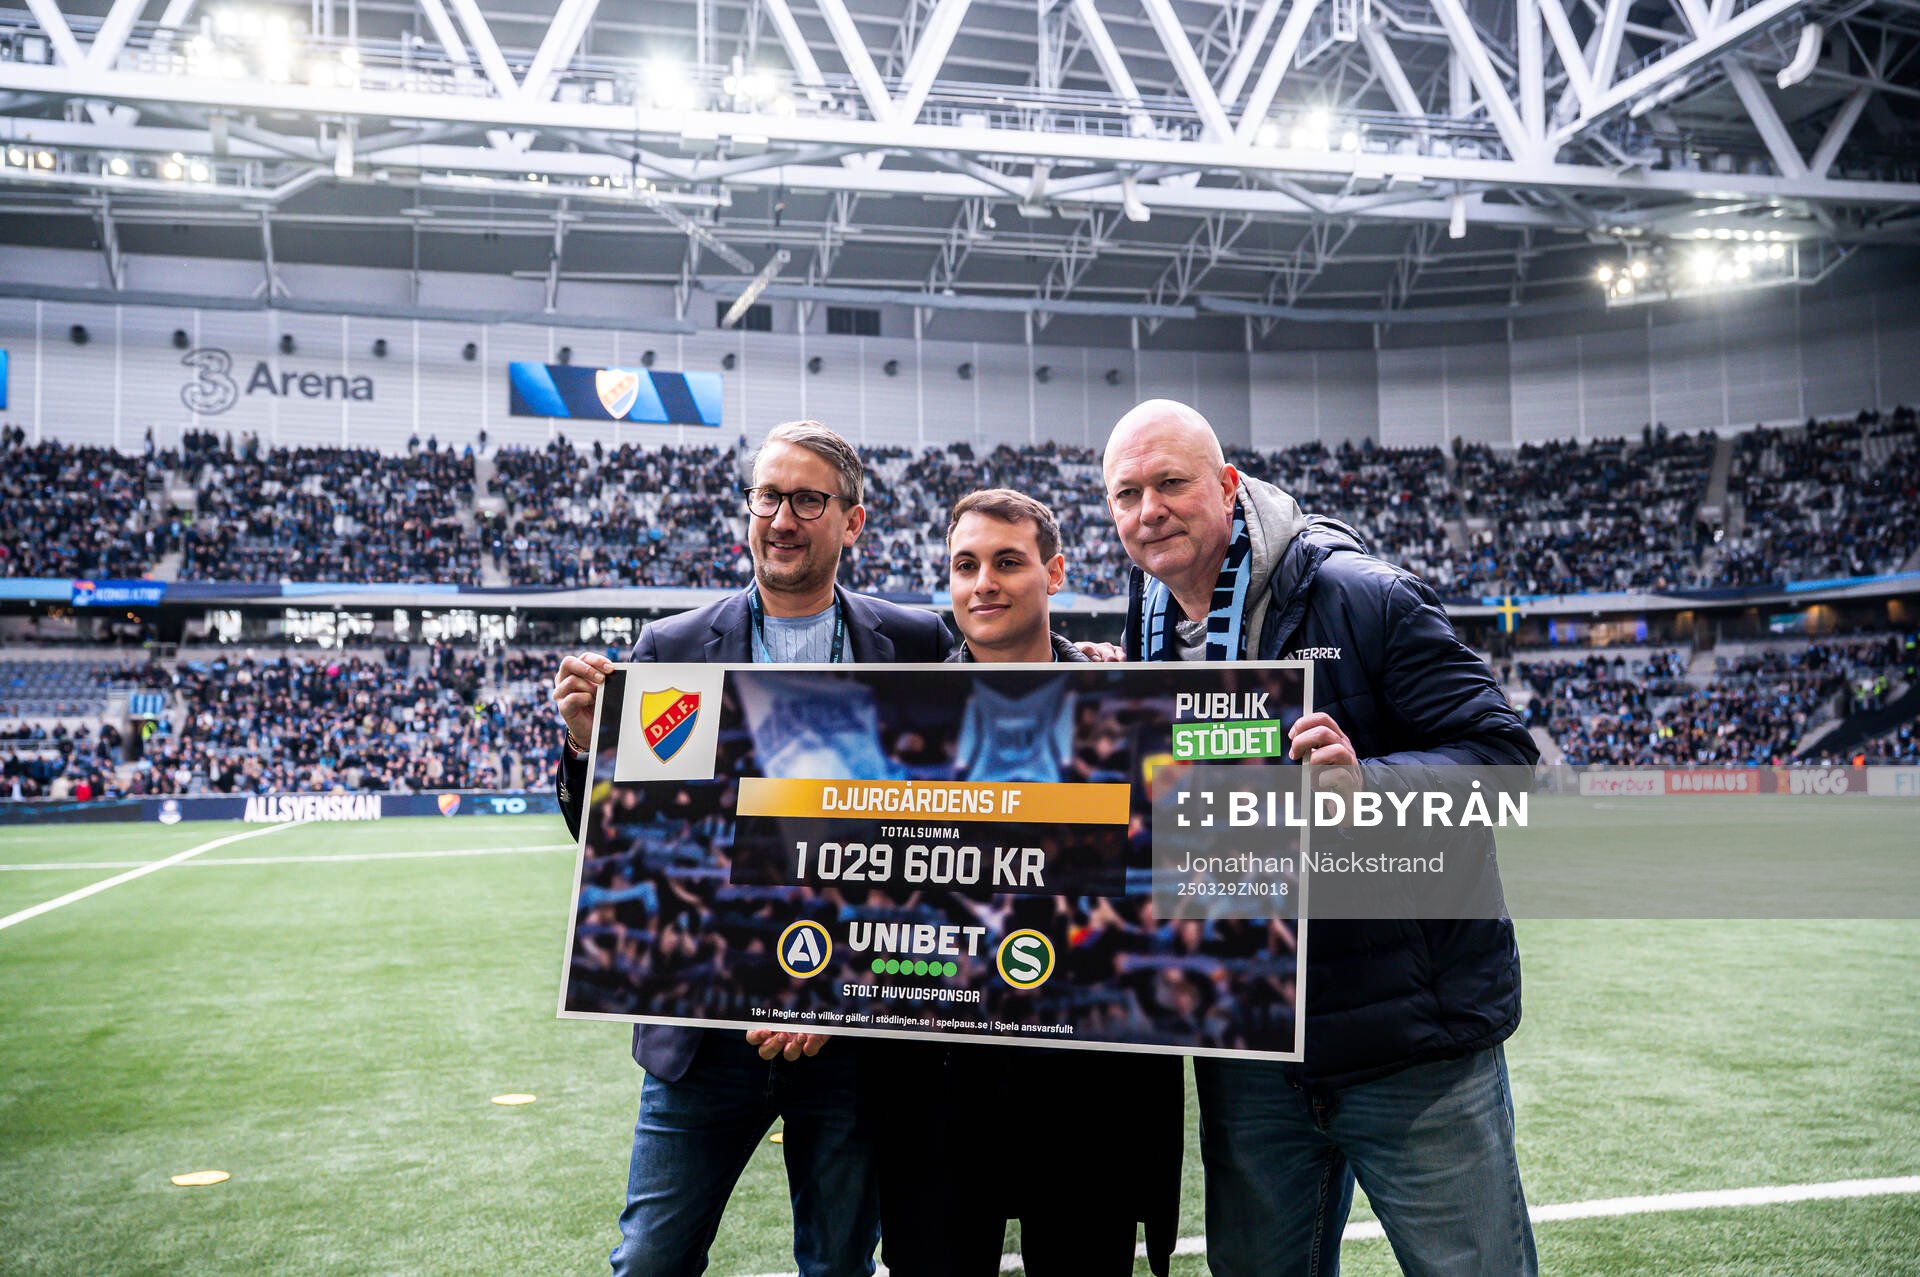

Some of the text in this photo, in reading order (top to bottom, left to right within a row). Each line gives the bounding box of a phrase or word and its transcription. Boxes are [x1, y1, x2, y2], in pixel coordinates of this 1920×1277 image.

[245, 360, 374, 401] Arena
[1295, 647, 1342, 660] TERREX
[1175, 692, 1270, 719] PUBLIK
[1175, 724, 1278, 757] STÖDET
[1670, 773, 1748, 792] BAUHAUS
[1790, 769, 1849, 795] BYGG
[244, 795, 382, 823] ALLSVENSKAN
[821, 781, 1022, 814] DJURGÅRDENS IF
[880, 826, 960, 840] TOTALSUMMA
[795, 841, 1046, 888] 1 029 600 KR
[848, 921, 986, 957] UNIBET
[842, 984, 981, 1003] STOLT HUVUDSPONSOR
[751, 1007, 1074, 1034] 18+ Regler och villkor gäller stödlinjen.se spelpaus.se Spela ansvarsfullt
